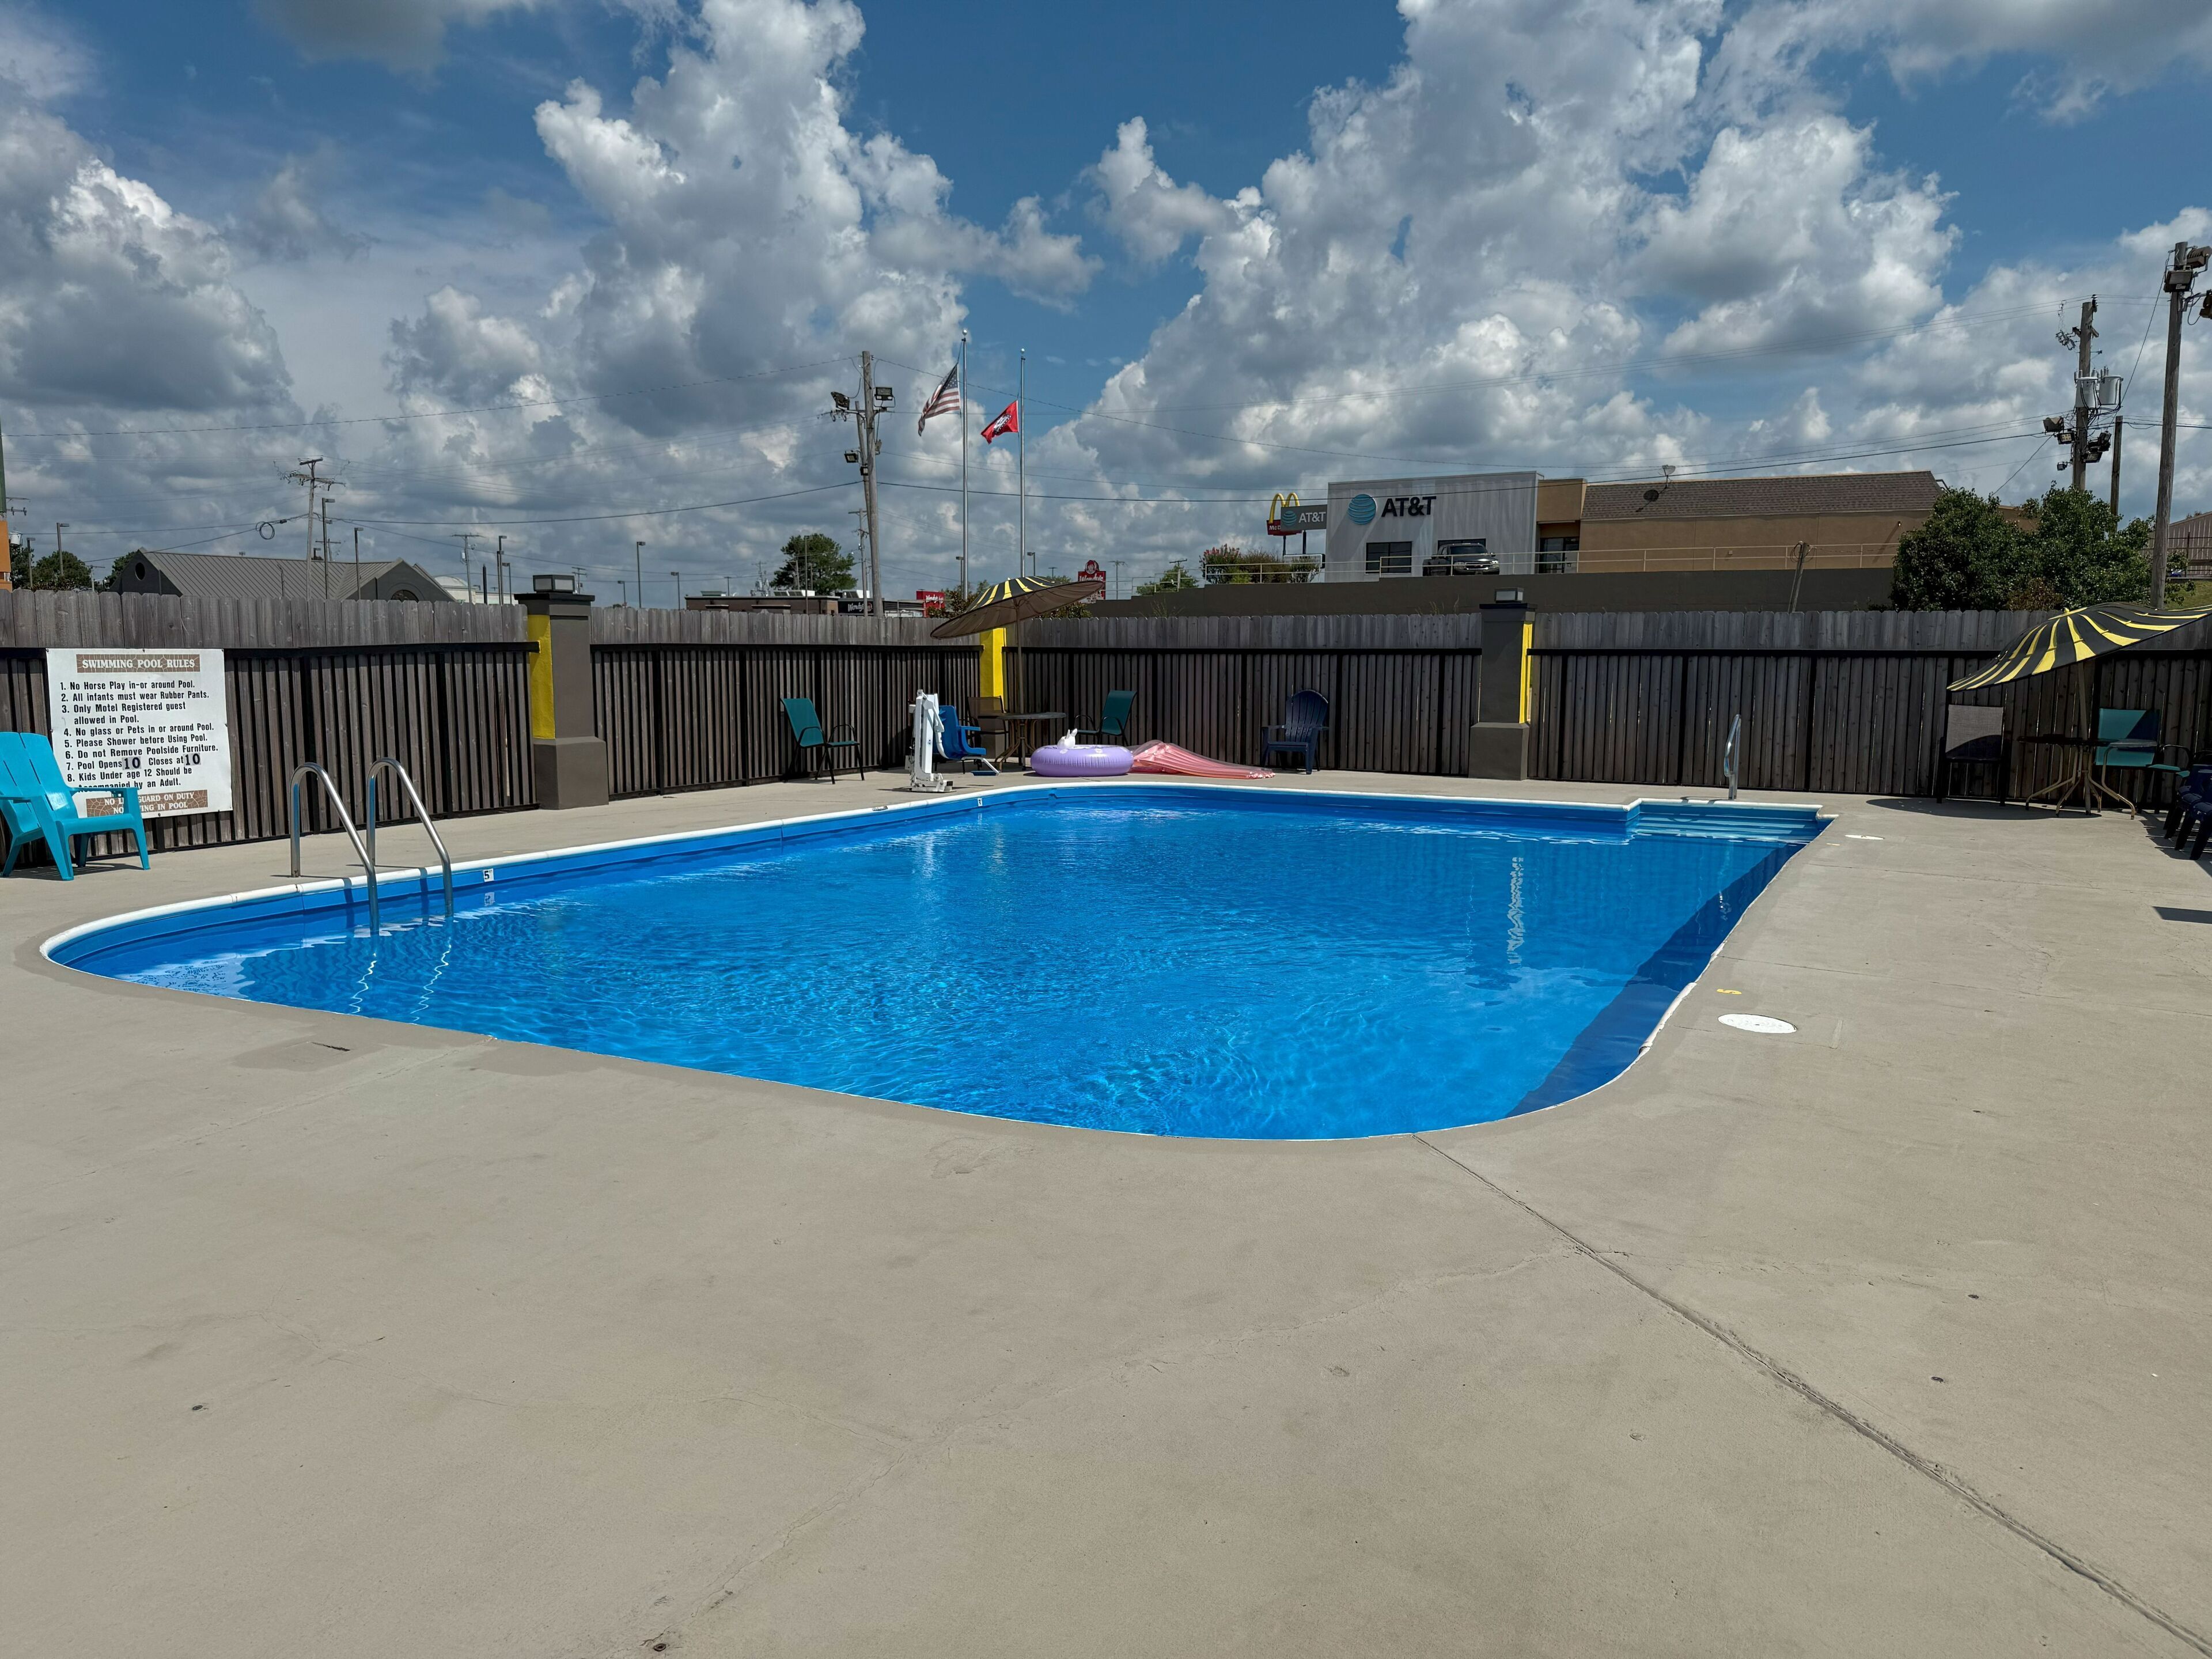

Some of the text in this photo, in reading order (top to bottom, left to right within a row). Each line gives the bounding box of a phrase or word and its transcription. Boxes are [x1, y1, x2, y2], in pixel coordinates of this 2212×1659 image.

[1381, 496, 1437, 517] AT&T
[1298, 512, 1326, 523] AT&T
[82, 659, 195, 668] SWIMMING POOL RULES
[60, 681, 66, 691] 1.
[70, 681, 80, 690] No
[84, 681, 106, 690] Horse
[109, 681, 126, 691] Play
[151, 680, 175, 689] around
[178, 680, 195, 688] Pool.
[61, 693, 69, 702] 2.
[73, 693, 83, 702] All
[86, 692, 114, 701] infants
[118, 692, 136, 700] must
[160, 691, 184, 699] Rubber
[187, 690, 209, 699] Pants.
[62, 701, 185, 714] 3. Only Motel Registered guest
[74, 714, 139, 725] allowed in Pool.
[63, 728, 71, 737] 4.
[75, 728, 86, 736] No
[90, 727, 112, 737] glass
[127, 725, 145, 734] Pets
[148, 725, 155, 733] in
[169, 723, 194, 732] around
[196, 722, 214, 731] Pool.
[64, 733, 208, 748] 5. Please Shower before Using Pool.
[65, 744, 218, 759] 6. Do not Remove Poolside Furniture.
[66, 753, 200, 771] 7. Pool Opens 10 Closes at 10
[67, 766, 192, 782] 8. Kids Under age 12 Should be
[134, 781, 143, 790] by
[160, 778, 181, 787] Adult.
[176, 791, 195, 800] DUTY
[169, 801, 188, 809] POOL
